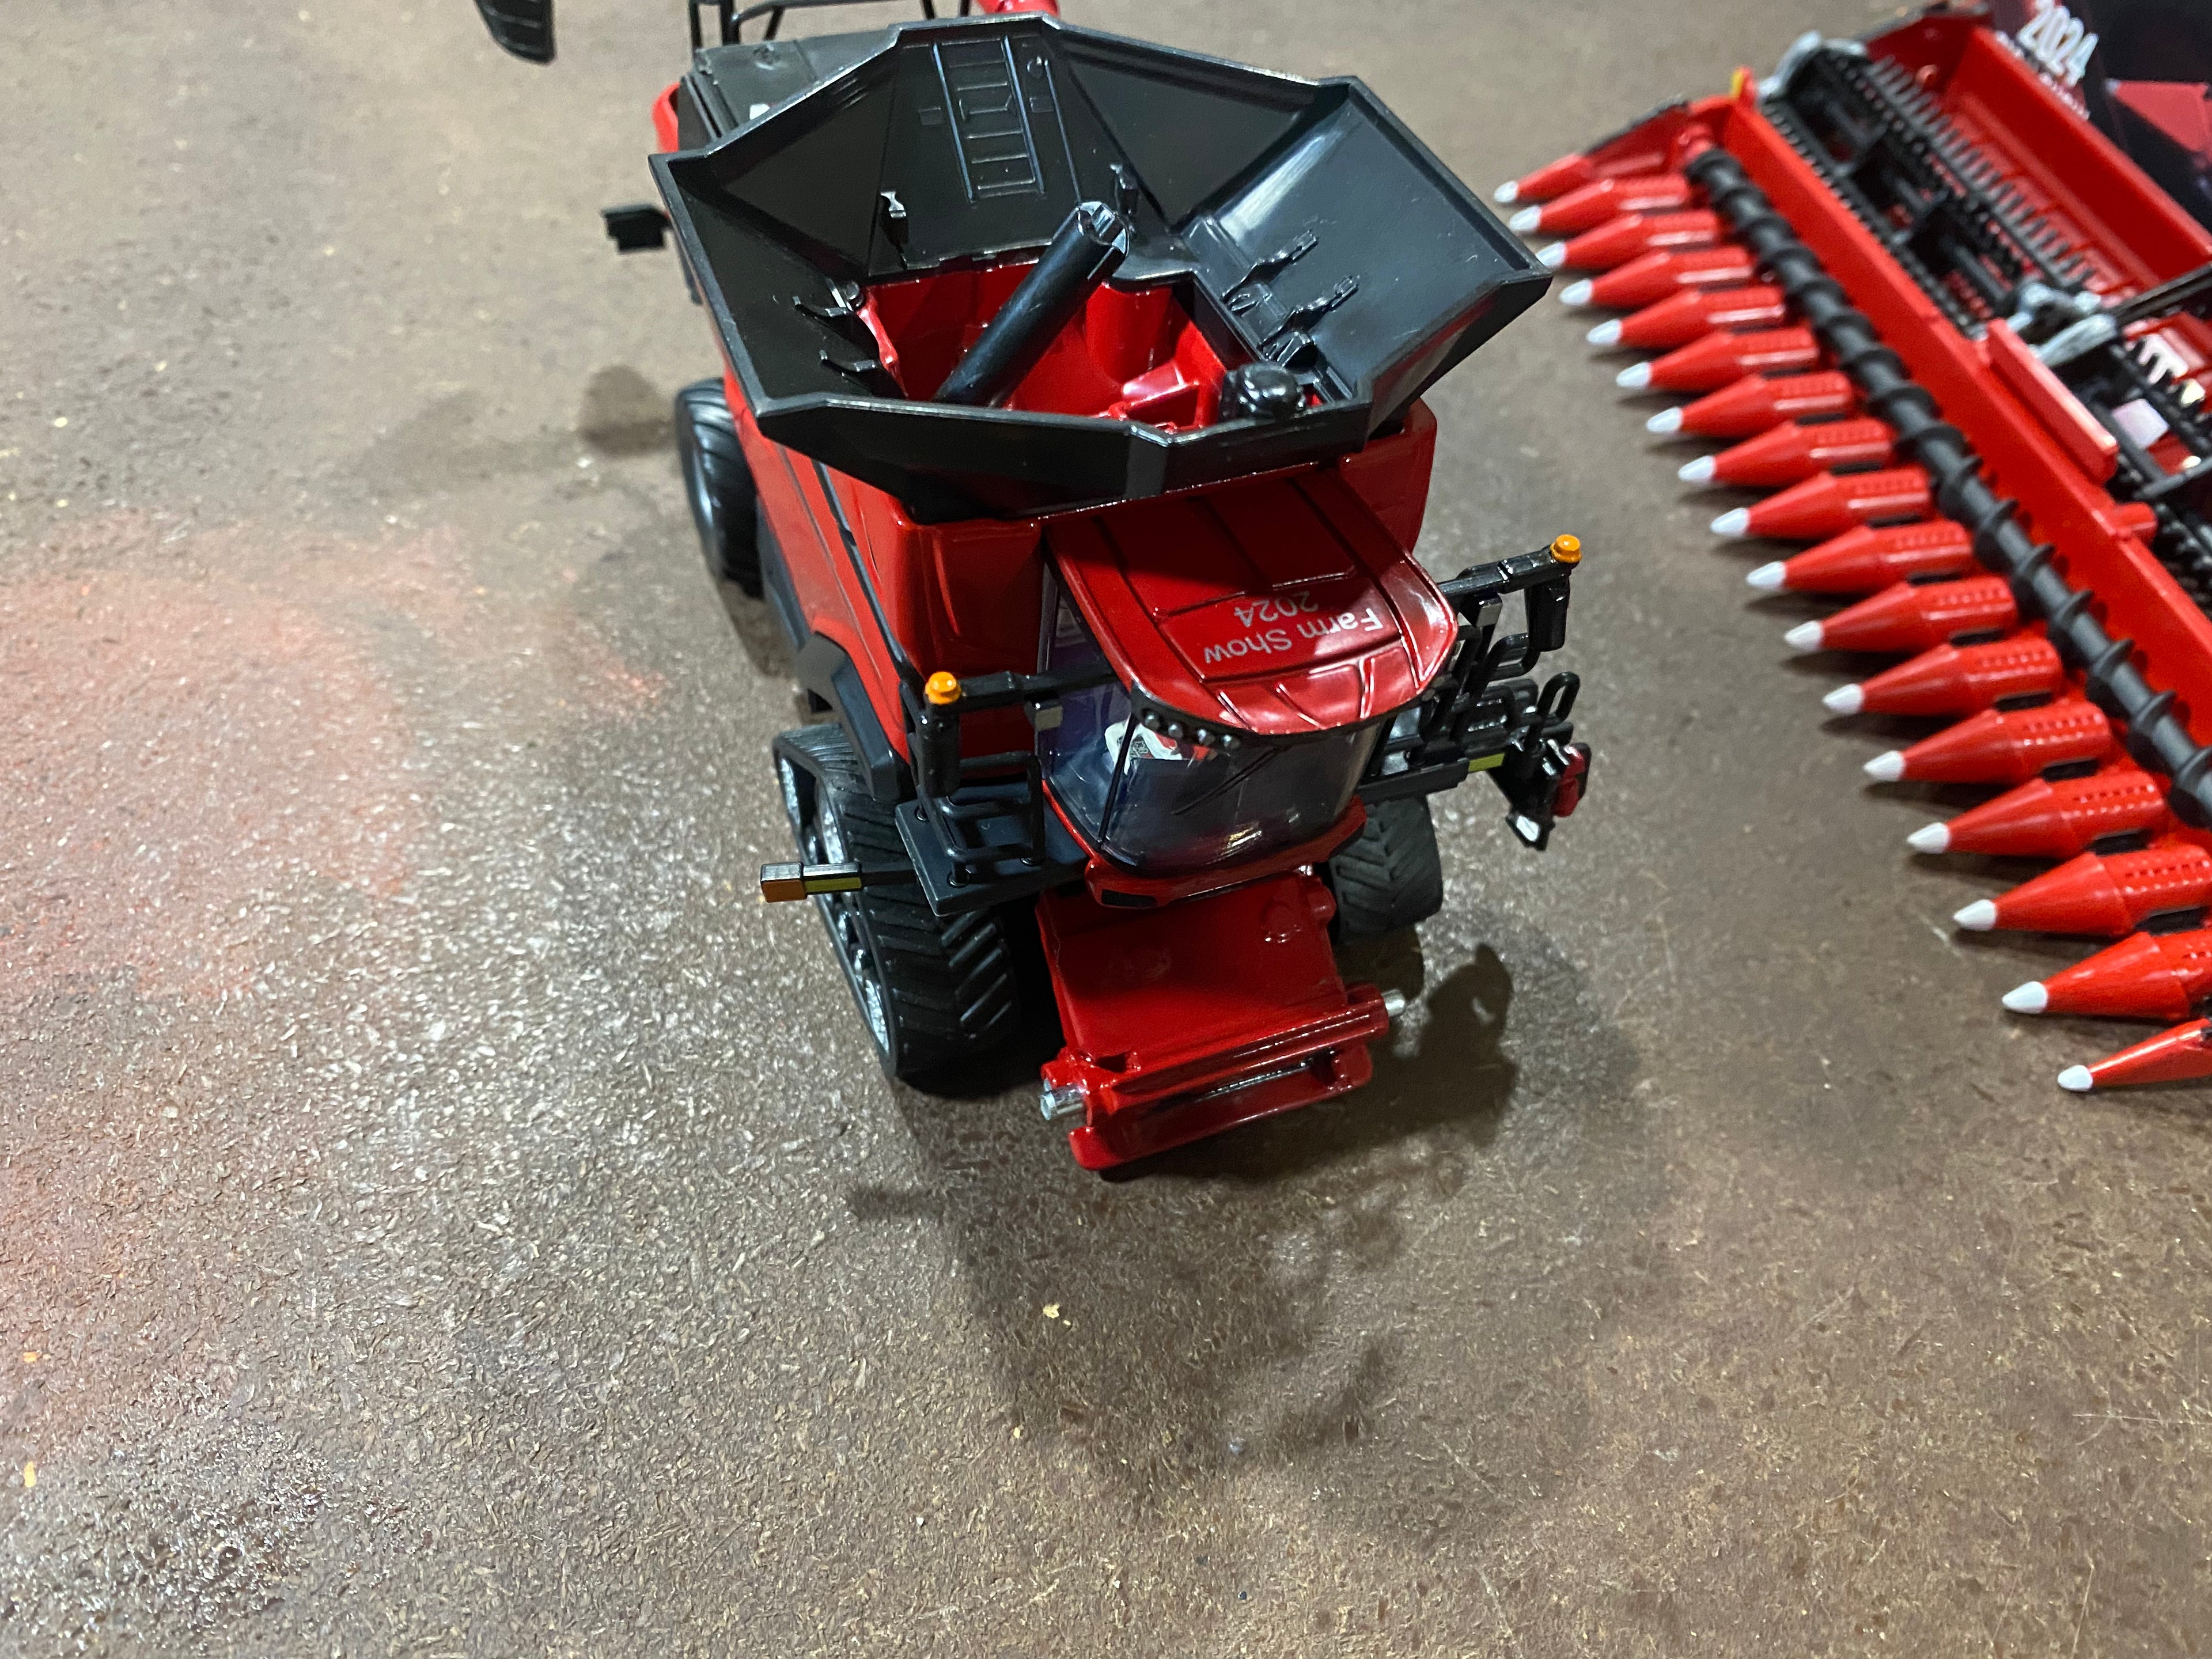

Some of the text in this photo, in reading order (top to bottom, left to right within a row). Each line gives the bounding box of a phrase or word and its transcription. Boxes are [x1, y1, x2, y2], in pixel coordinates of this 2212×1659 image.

[2017, 0, 2099, 87] 2024
[1204, 608, 1384, 664] Farm Show
[1234, 590, 1319, 627] 2024
